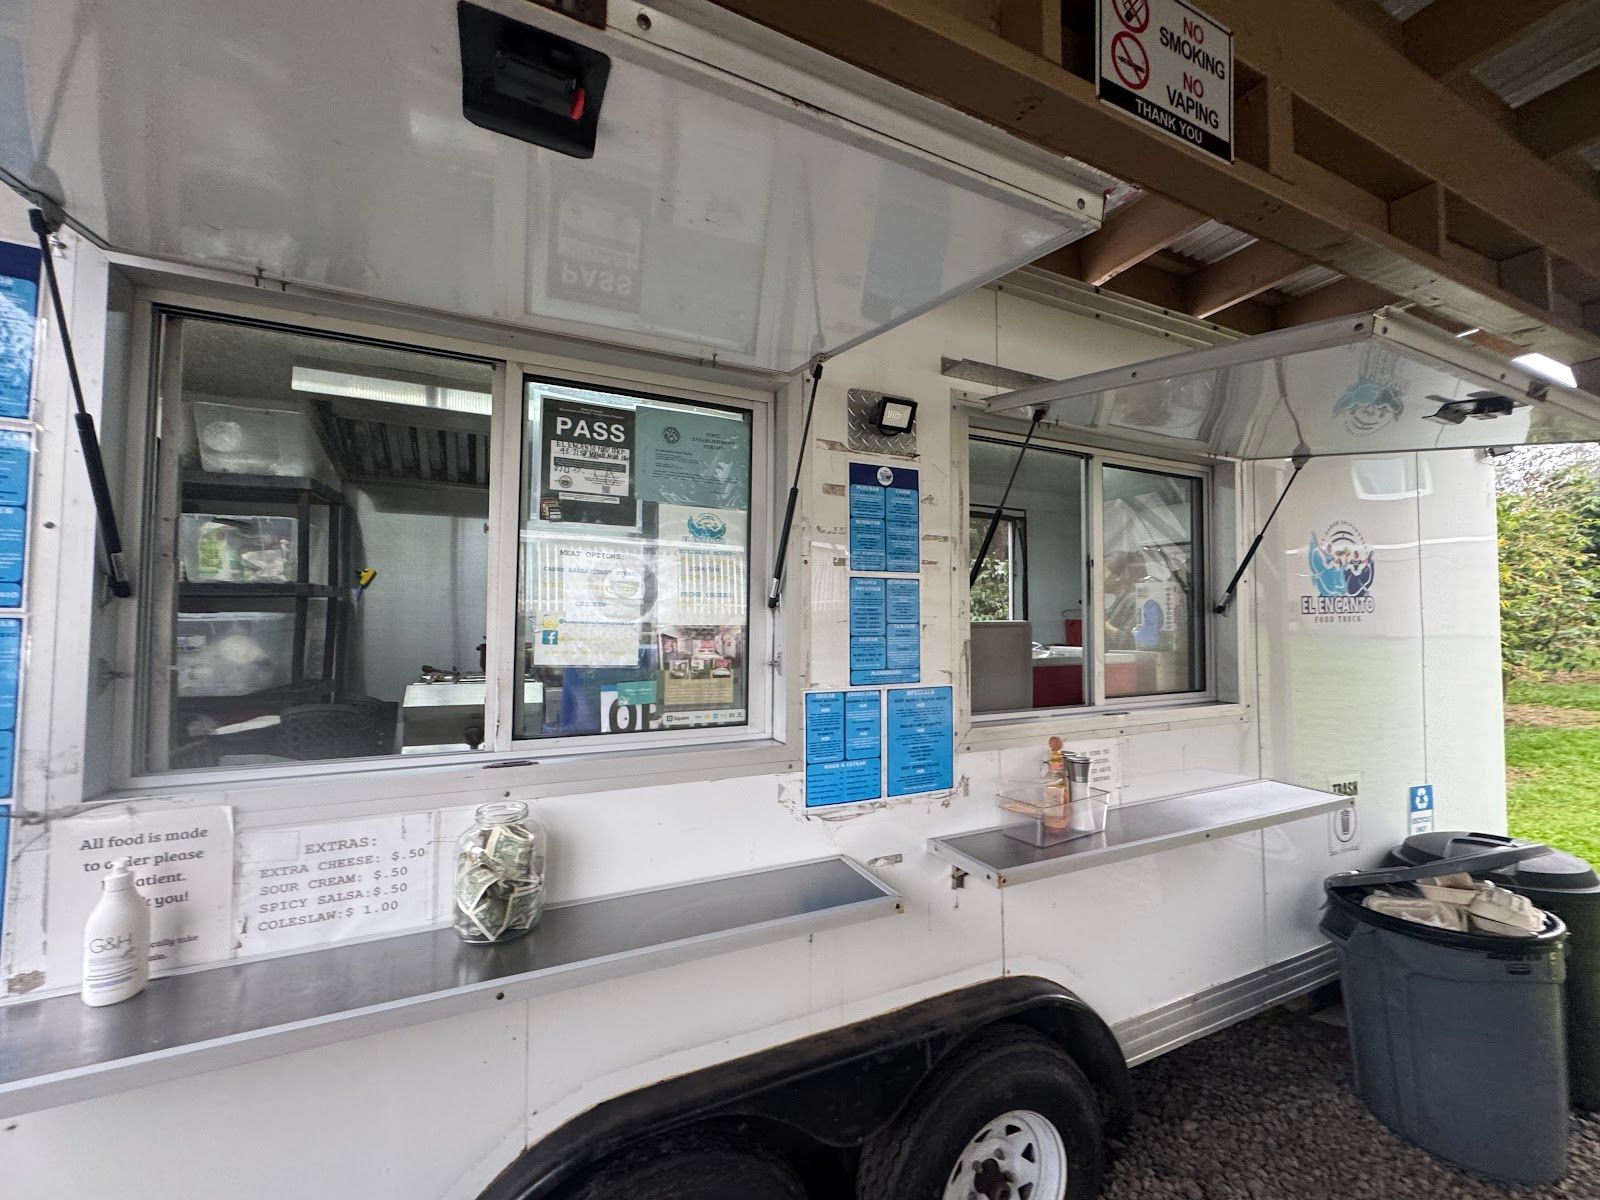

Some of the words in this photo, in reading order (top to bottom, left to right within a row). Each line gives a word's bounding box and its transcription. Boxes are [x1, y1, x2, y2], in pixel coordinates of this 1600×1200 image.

[1183, 17, 1204, 45] NO
[1160, 26, 1225, 80] SMOKING
[1183, 72, 1204, 99] NO
[1166, 85, 1219, 130] VAPING
[1136, 98, 1176, 132] THANK
[1178, 120, 1203, 144] YOU
[556, 416, 626, 443] PASS
[586, 552, 625, 560] OPTIONS:
[1301, 596, 1317, 614] EL
[1318, 596, 1374, 614] ENCANTO
[1332, 781, 1358, 796] TRASH
[80, 837, 104, 851] All
[108, 834, 144, 848] food
[148, 832, 162, 843] is
[165, 827, 208, 841] made
[304, 837, 376, 854] EXTRAS:
[83, 862, 101, 872] to
[153, 850, 204, 867] please
[260, 864, 309, 878] EXTRA
[318, 855, 380, 870] CHEESE:
[391, 847, 425, 861] $.50
[135, 872, 188, 887] atient.
[260, 882, 299, 896] SOUR
[308, 873, 362, 889] CREAM:
[373, 866, 408, 880] $.50
[154, 890, 189, 908] you!
[259, 898, 308, 913] SPICY
[363, 900, 399, 914] 1.00
